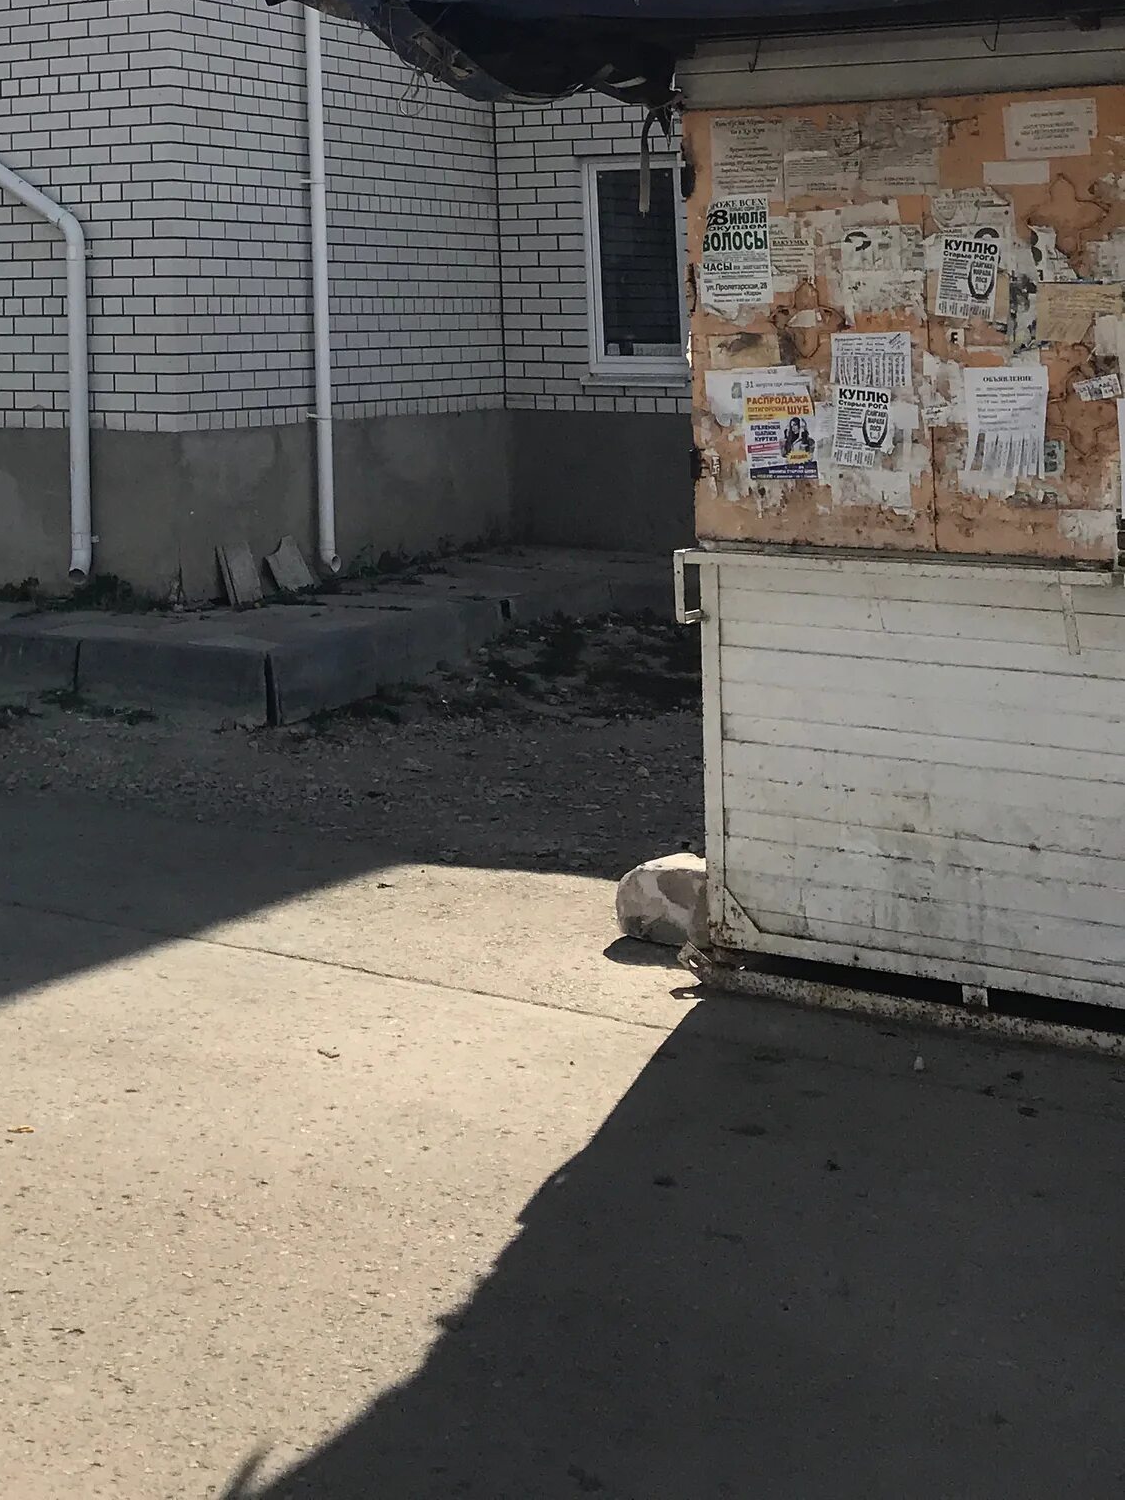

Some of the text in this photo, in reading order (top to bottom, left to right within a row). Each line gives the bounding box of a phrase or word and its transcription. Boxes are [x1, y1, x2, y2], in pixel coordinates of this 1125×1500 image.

[711, 200, 737, 209] ОЖЕ
[729, 211, 767, 225] ИЮЛЯ
[707, 224, 767, 232] окупаем
[703, 230, 768, 252] ВОЛОСЫ
[944, 239, 998, 255] КУПЛЮ
[943, 250, 995, 262] Старые РОГА
[703, 262, 732, 271] ЧАСЫ
[745, 381, 754, 389] 31
[746, 396, 809, 405] РАСПРОДАЖА
[838, 388, 889, 404] КУПЛЮ
[786, 405, 810, 415] ШУБ
[838, 400, 888, 410] Старые РОГА
